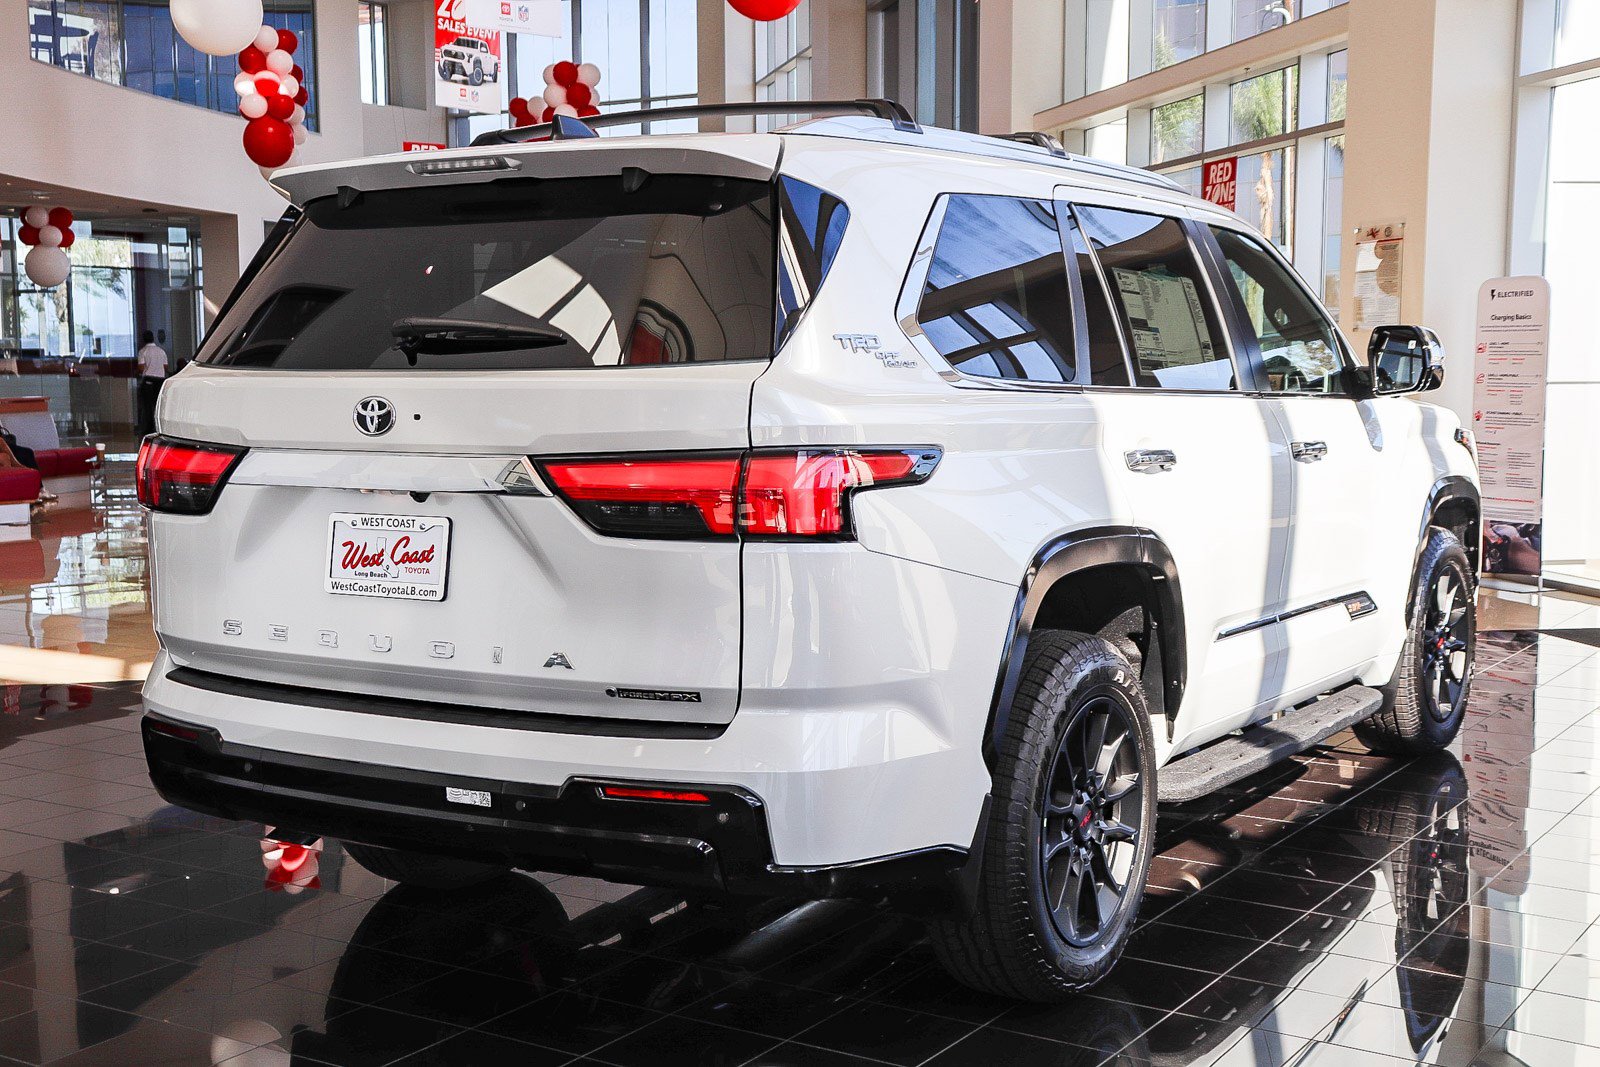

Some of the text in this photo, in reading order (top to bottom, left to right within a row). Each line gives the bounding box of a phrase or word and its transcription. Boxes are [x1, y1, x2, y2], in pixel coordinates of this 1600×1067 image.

[437, 18, 498, 40] SALES EVENT
[1209, 161, 1232, 185] RED
[1205, 180, 1236, 204] ZONE
[1497, 290, 1534, 298] ELECTRIFIED
[1490, 314, 1515, 322] Charging
[833, 334, 881, 354] TRD
[361, 517, 416, 528] WEST COAST
[341, 535, 435, 569] West Coast
[354, 570, 369, 578] Long
[404, 566, 430, 575] TOYOTA
[331, 581, 437, 597] WestCoastToyotaLB.com
[223, 619, 575, 670] SEQUOIA
